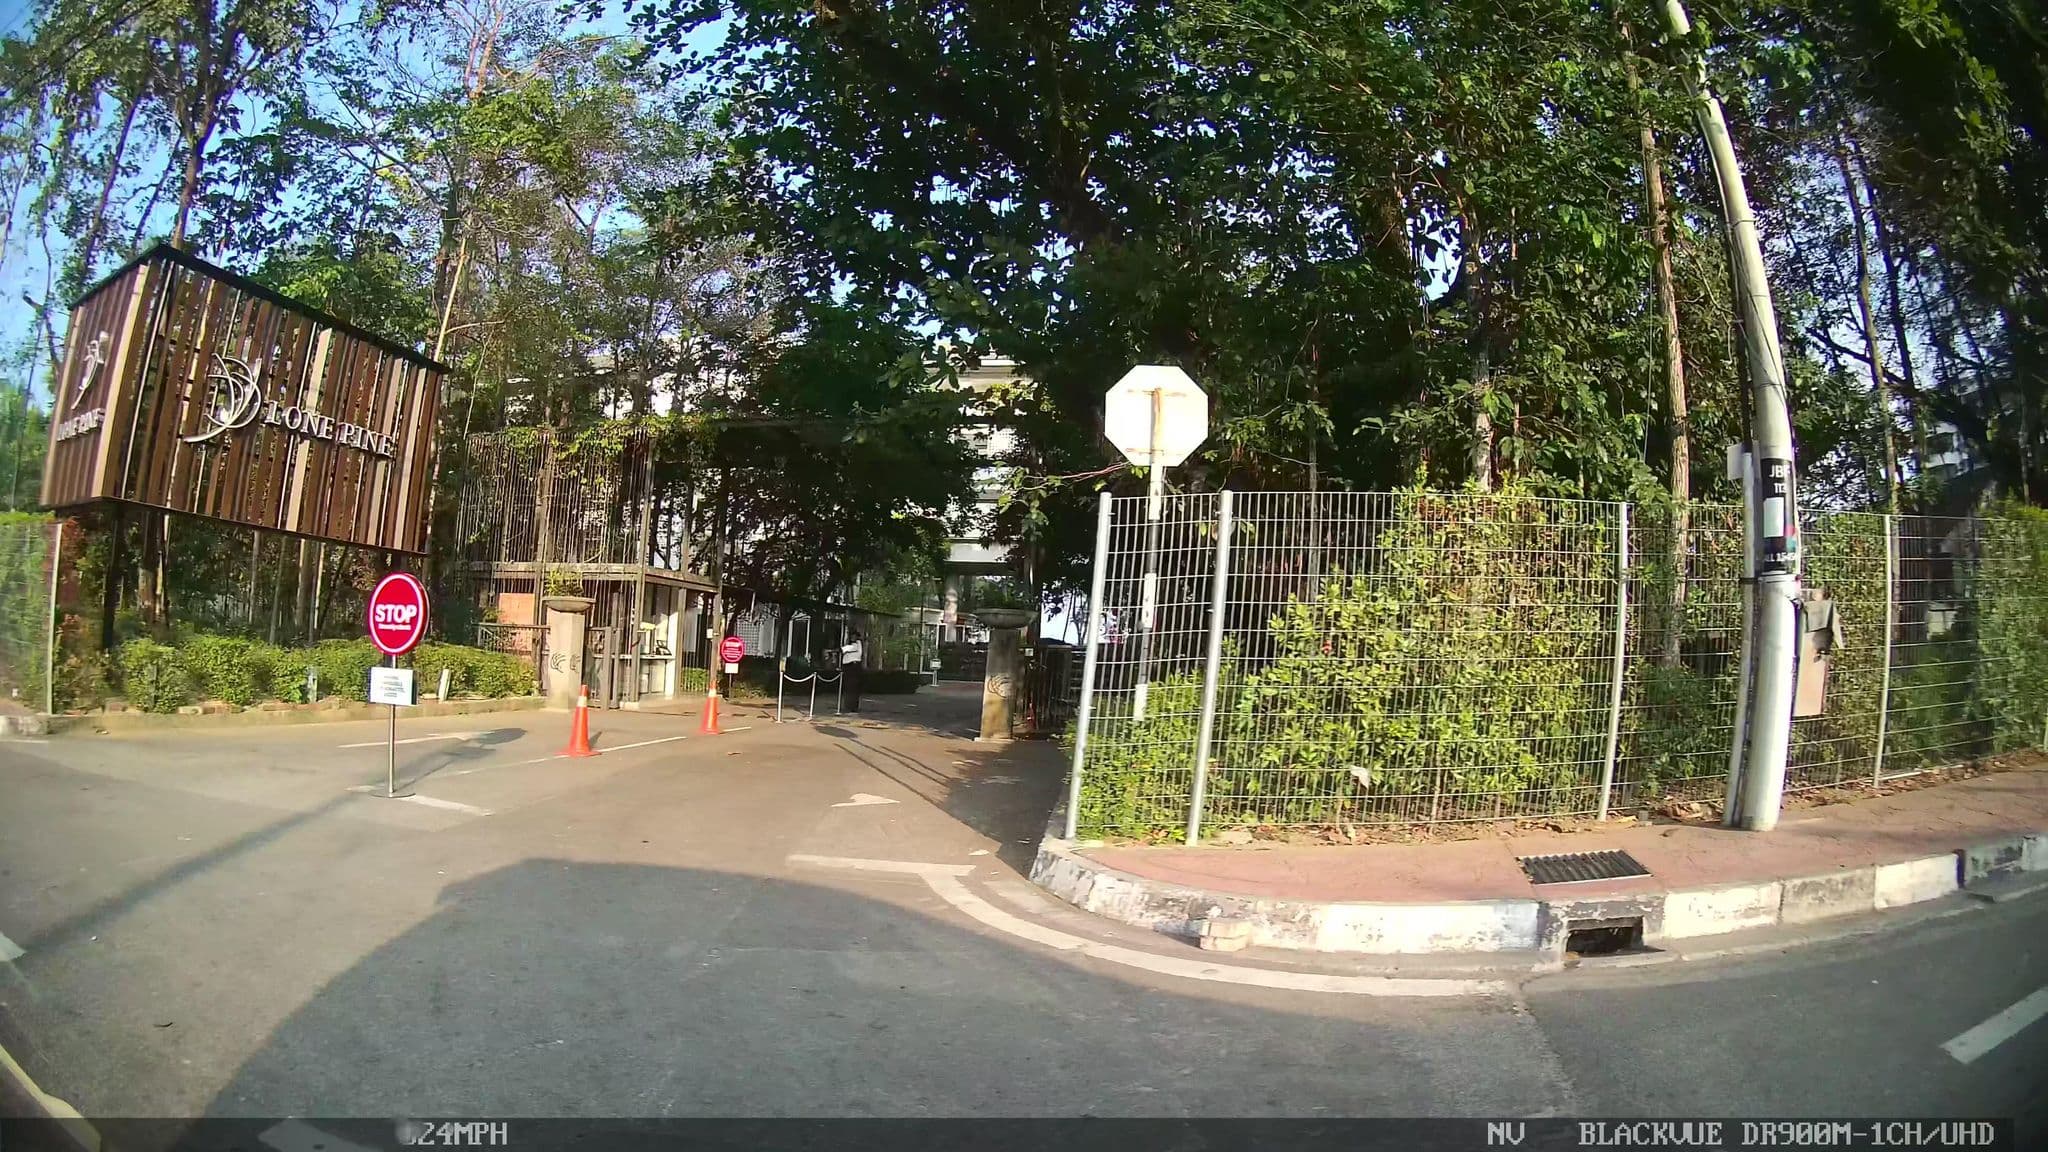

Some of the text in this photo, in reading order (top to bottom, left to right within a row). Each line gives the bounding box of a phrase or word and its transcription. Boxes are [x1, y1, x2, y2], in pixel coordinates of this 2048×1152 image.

[264, 400, 394, 458] LONE PINE
[375, 604, 417, 623] STOP
